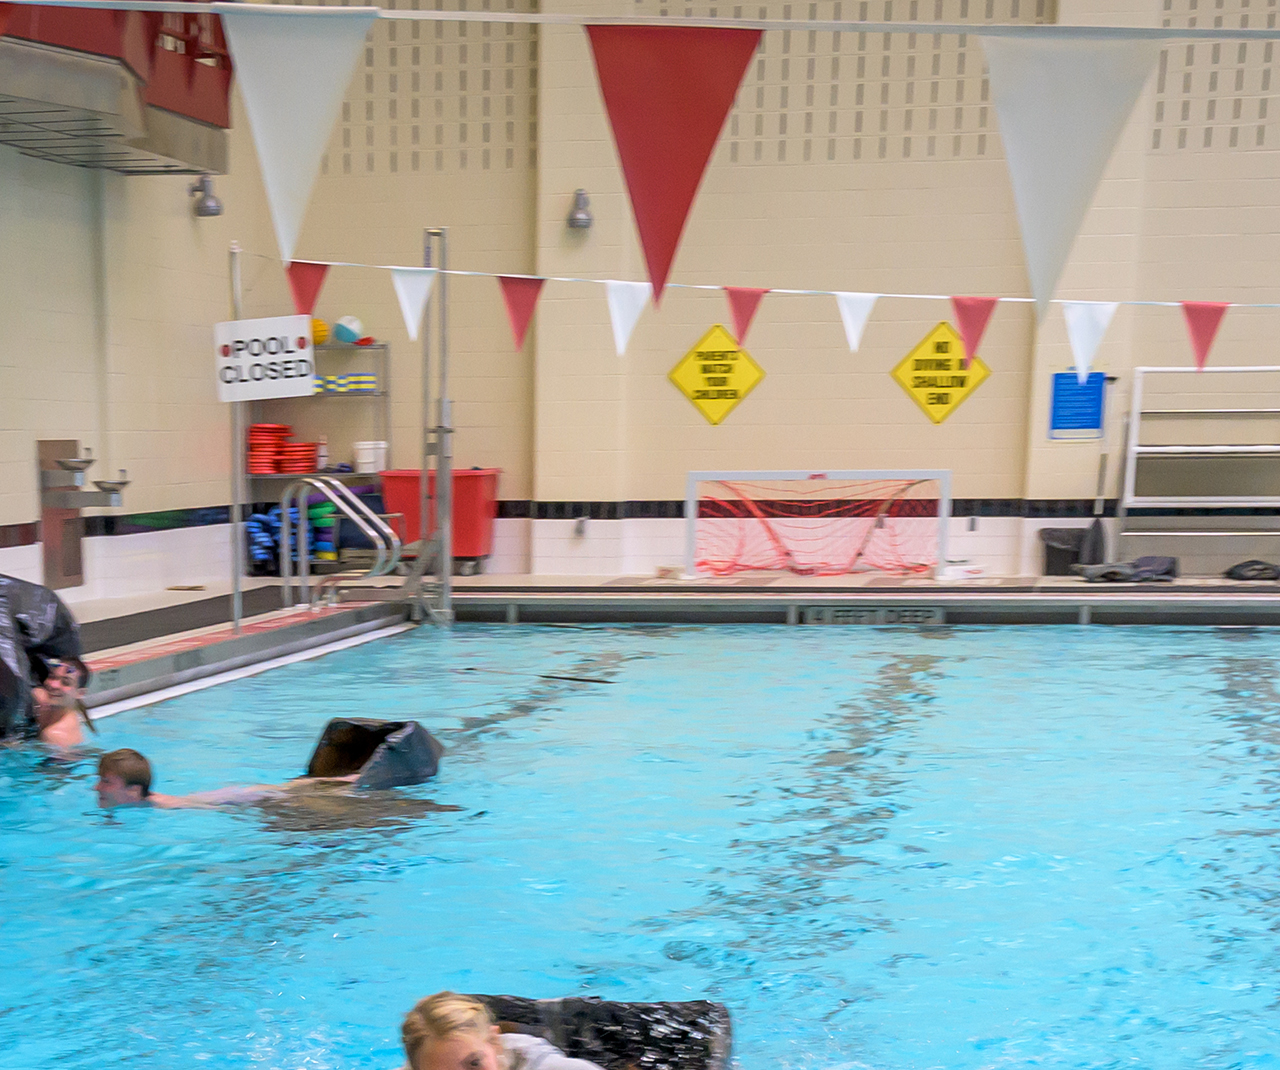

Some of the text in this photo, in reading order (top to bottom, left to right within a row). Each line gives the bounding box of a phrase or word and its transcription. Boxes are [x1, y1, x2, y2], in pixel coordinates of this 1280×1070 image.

[233, 336, 296, 358] POOL
[934, 341, 950, 353] NO
[695, 350, 739, 361] PARENTS
[700, 364, 734, 374] WATCH
[913, 359, 951, 371] DIVING
[219, 359, 314, 384] CLOSED
[705, 377, 728, 387] YOUR
[912, 375, 967, 388] SHALLOW
[693, 389, 740, 400] CHILDREN
[926, 392, 950, 405] END
